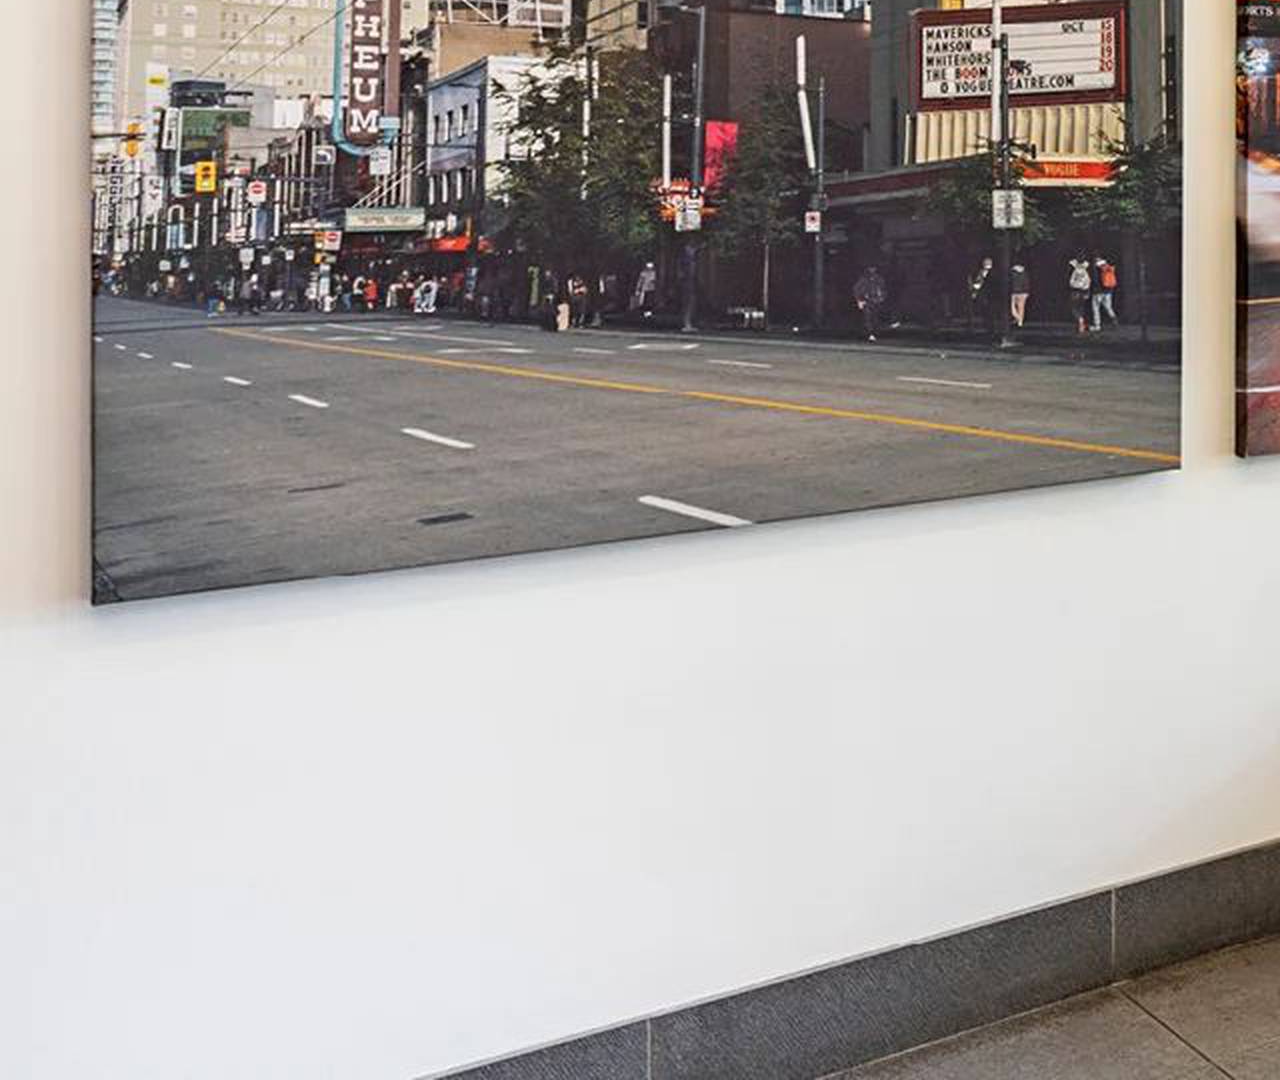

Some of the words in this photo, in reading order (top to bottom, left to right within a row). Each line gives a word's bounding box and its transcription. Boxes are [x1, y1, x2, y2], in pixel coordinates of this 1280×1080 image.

[926, 25, 993, 39] MAVERICKS
[926, 40, 972, 54] HANSON
[926, 51, 992, 67] WHITEHORS
[926, 67, 946, 81] THE
[955, 65, 988, 80] BOOM
